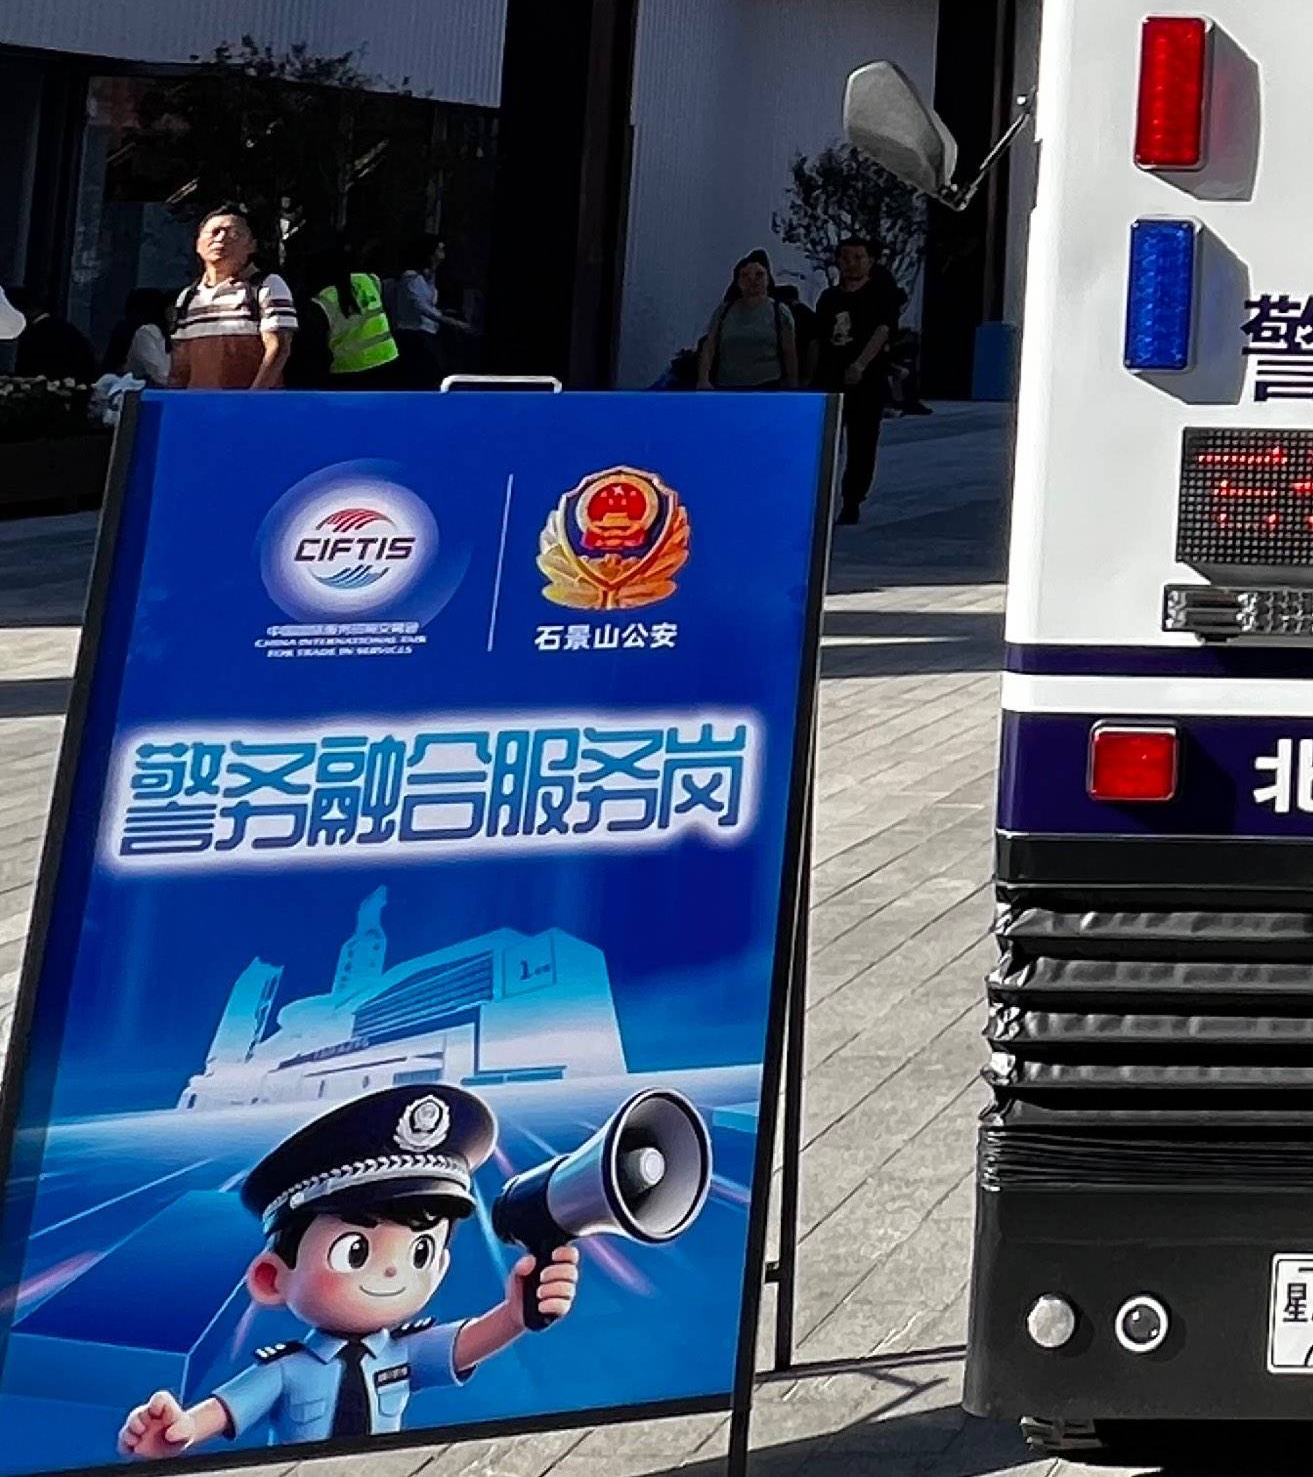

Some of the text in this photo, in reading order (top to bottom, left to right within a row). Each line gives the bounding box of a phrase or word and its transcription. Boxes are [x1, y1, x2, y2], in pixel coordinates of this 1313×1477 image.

[294, 536, 417, 562] CIFTIS
[534, 621, 678, 651] 石景山公安
[119, 722, 748, 856] 警务融合服务岗
